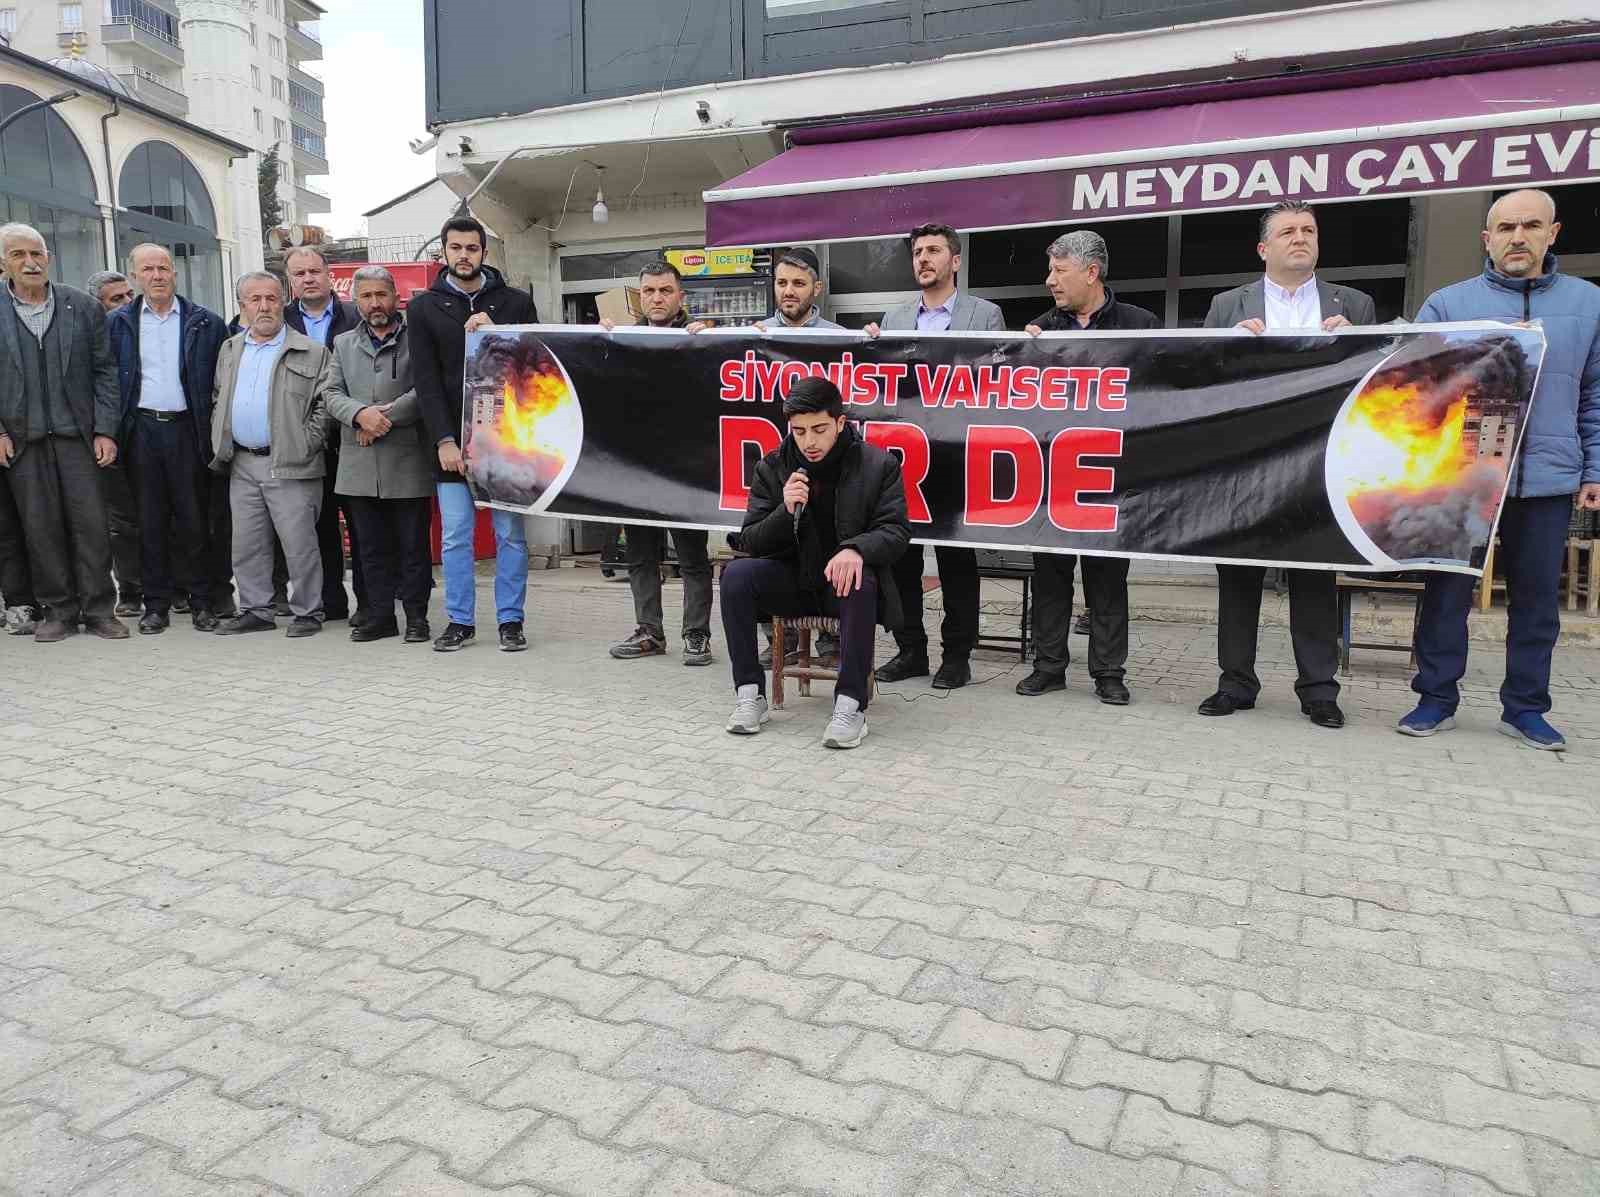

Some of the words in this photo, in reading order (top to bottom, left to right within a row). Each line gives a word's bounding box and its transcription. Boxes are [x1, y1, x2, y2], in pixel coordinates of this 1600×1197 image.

[1071, 153, 1329, 211] MEYDAN
[1345, 139, 1478, 195] ÇAY
[715, 255, 735, 265] ICE
[735, 254, 752, 264] TEA
[915, 363, 1131, 412] VAHSETE
[718, 415, 933, 524] DR
[963, 424, 1124, 533] DE
